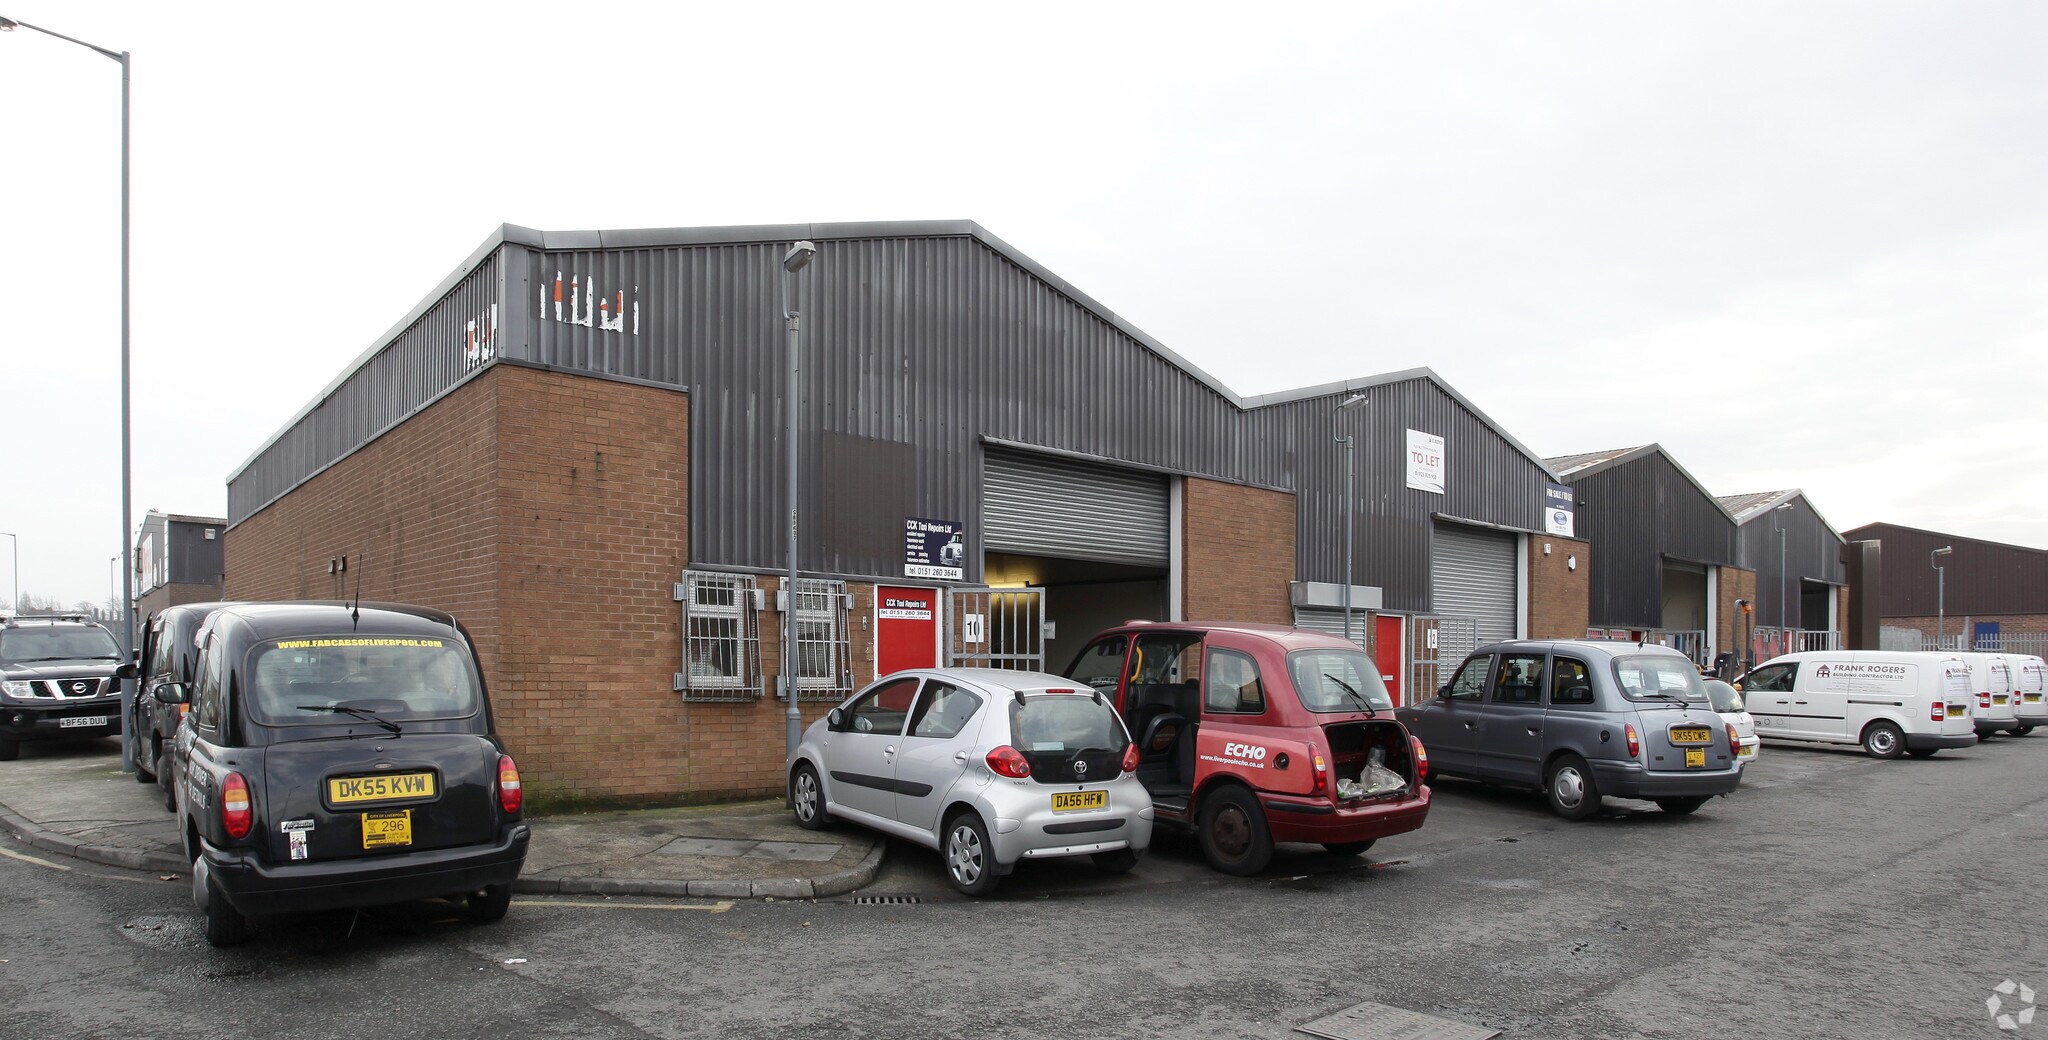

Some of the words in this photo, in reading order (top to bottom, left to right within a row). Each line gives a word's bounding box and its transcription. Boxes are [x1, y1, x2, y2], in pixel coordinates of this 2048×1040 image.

[1412, 452, 1424, 464] TO
[1426, 455, 1440, 467] LET
[918, 522, 927, 531] Taxi
[928, 523, 944, 533] Repairs
[918, 567, 931, 575] 0151
[905, 600, 919, 608] Repairs
[967, 621, 980, 635] 10
[277, 639, 444, 649] WWW.FABCABSOFLIVERPOOL.COM
[1867, 666, 1905, 674] ROGERS
[90, 717, 106, 725] DUU
[1674, 732, 1692, 741] DK55
[1693, 732, 1707, 741] CWE
[1224, 742, 1266, 760] ECHO
[1200, 754, 1265, 769] www.liverpoolecho.co.uk
[339, 780, 386, 798] DK55
[391, 776, 425, 794] KVW
[1056, 794, 1081, 808] DA56
[1084, 793, 1102, 806] HFW
[381, 820, 405, 832] 296
